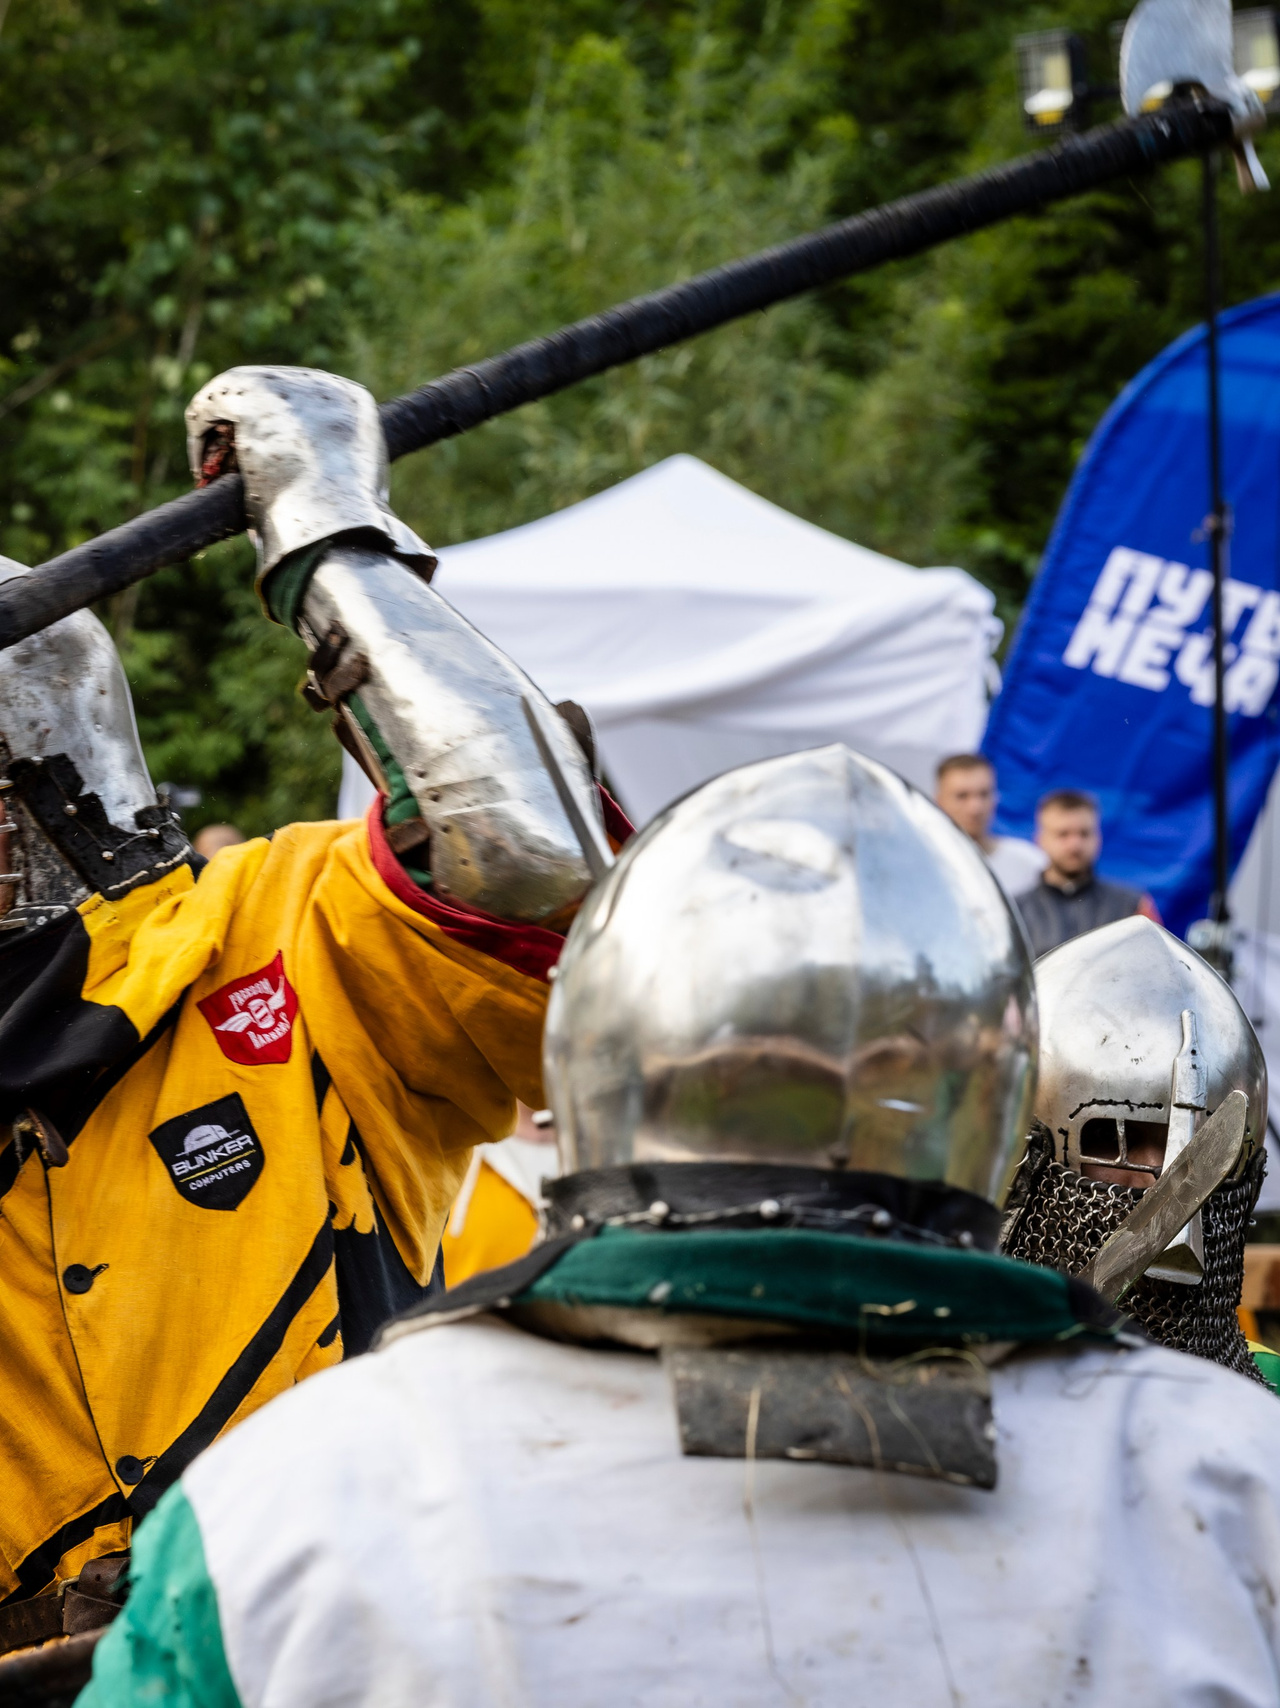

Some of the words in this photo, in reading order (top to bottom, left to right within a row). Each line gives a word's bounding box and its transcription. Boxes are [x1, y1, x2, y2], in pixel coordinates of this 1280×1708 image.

[1062, 607, 1279, 718] МЕЧА
[171, 1134, 254, 1176] BUNKER
[188, 1159, 252, 1191] COMPUTERS
